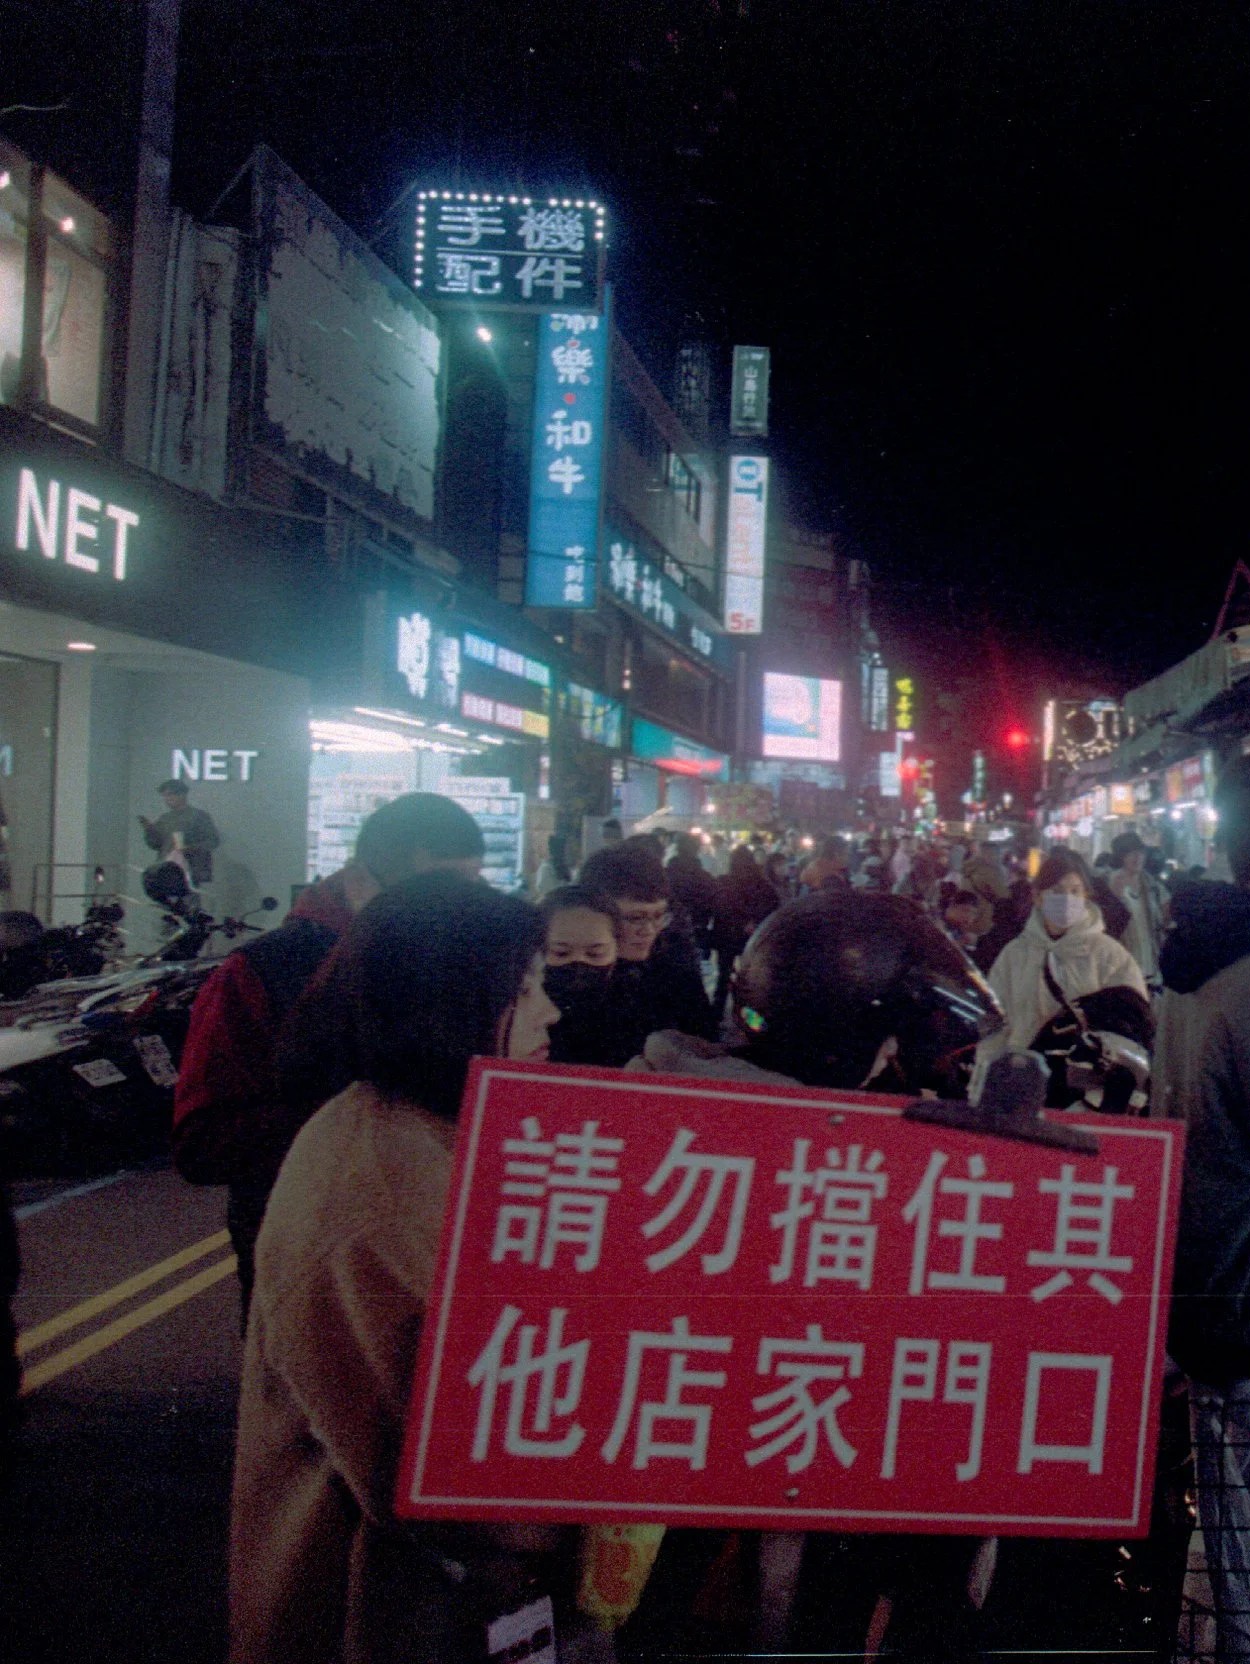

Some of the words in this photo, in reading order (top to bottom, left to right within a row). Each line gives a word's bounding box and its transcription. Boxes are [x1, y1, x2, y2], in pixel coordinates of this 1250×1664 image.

[436, 205, 586, 253] 手機
[436, 254, 583, 299] 配件
[15, 467, 140, 581] NET
[172, 749, 260, 781] NET
[491, 1116, 1137, 1305] 請勿擋住其
[466, 1304, 1114, 1483] 他店家門口
